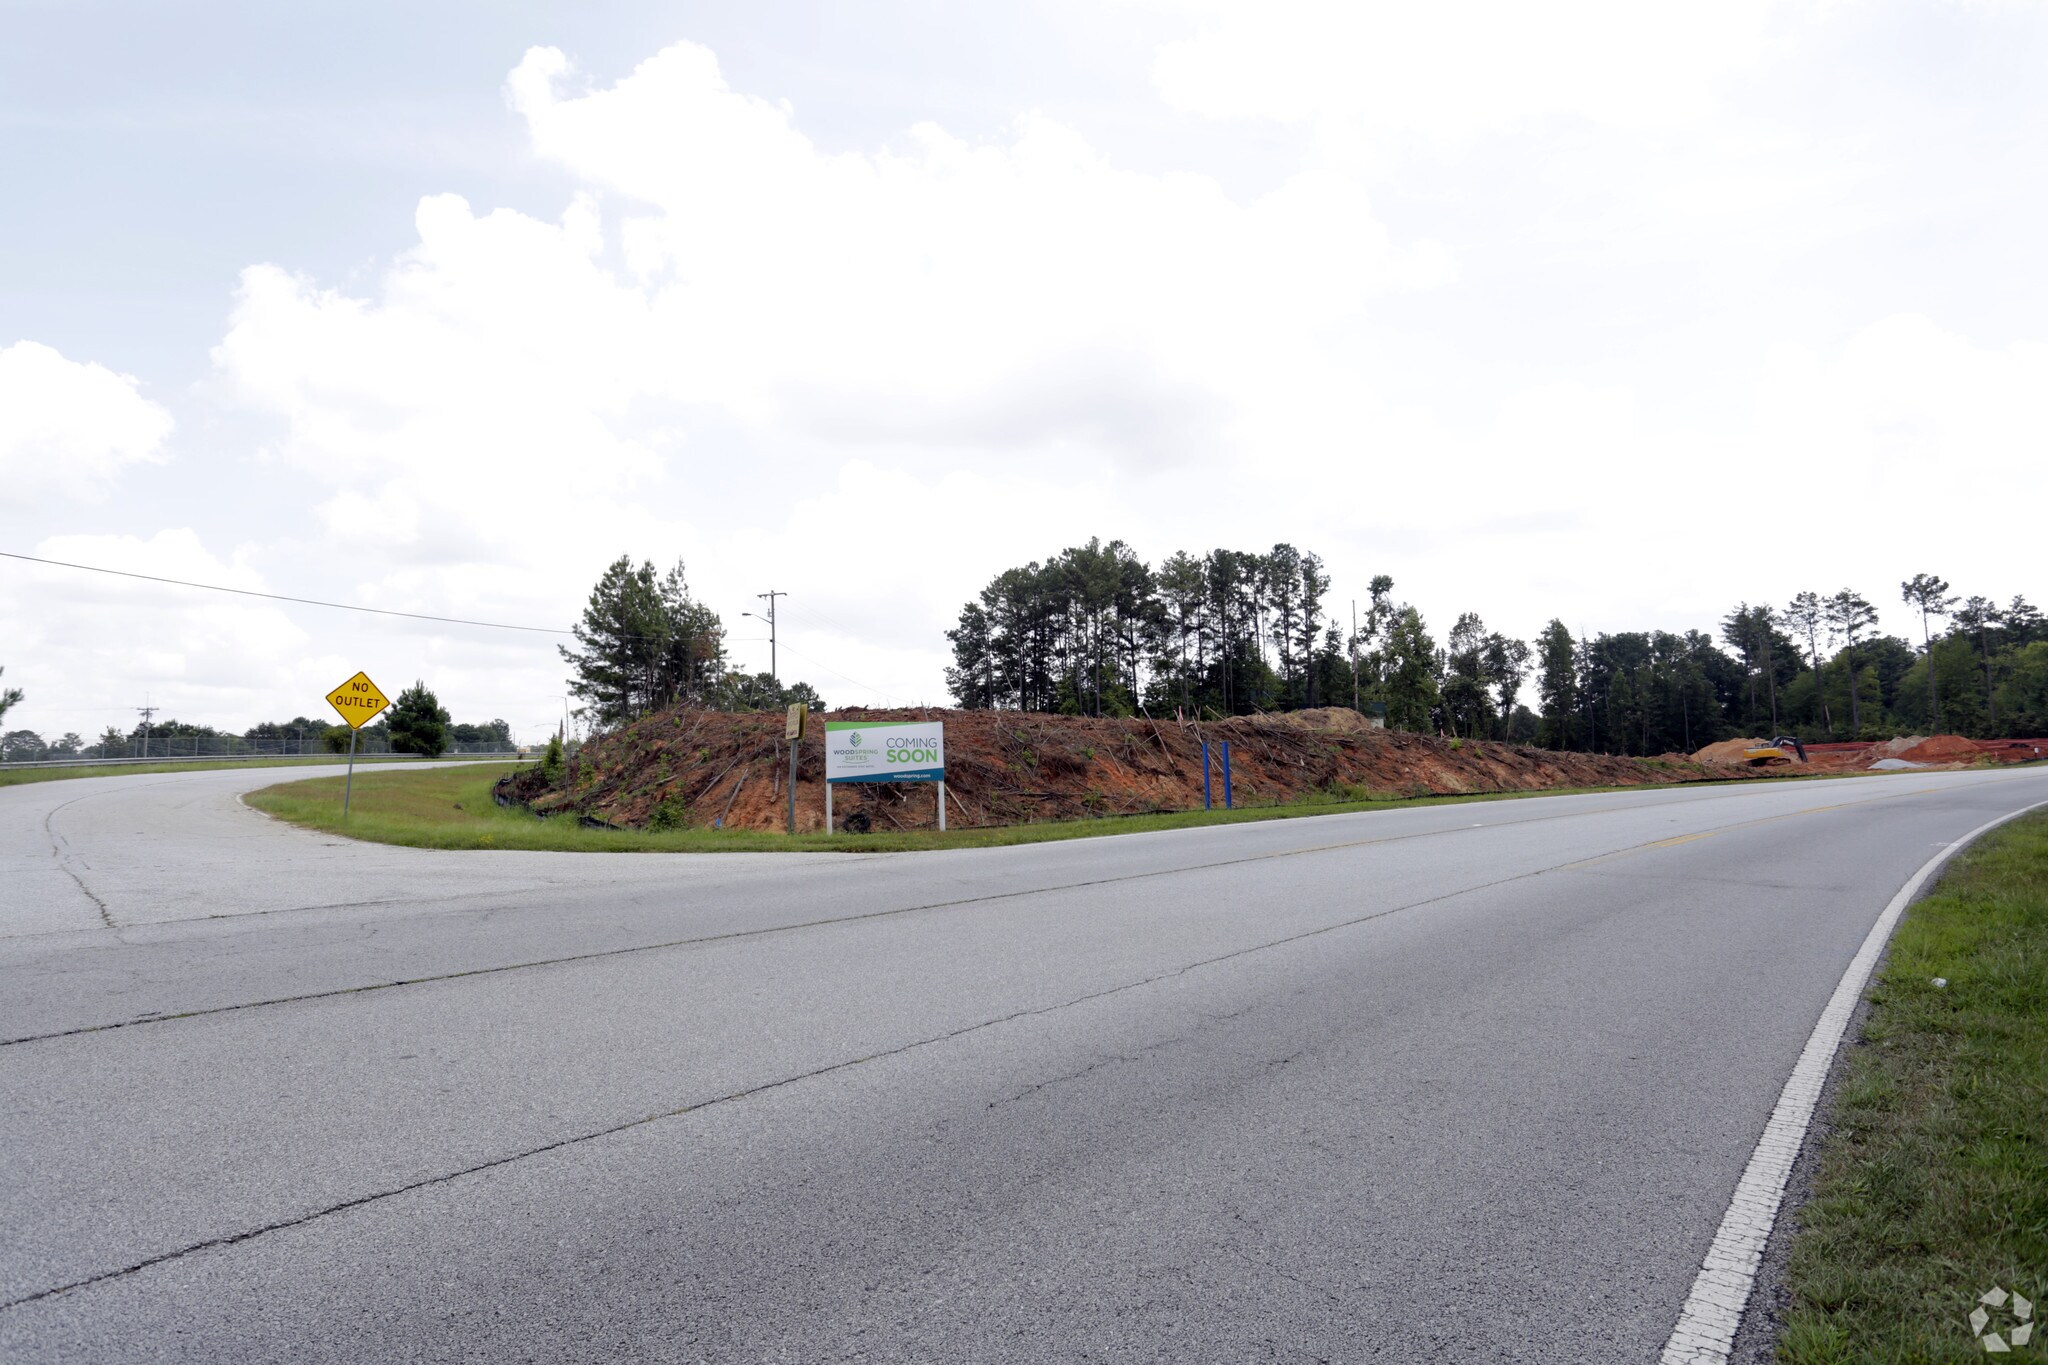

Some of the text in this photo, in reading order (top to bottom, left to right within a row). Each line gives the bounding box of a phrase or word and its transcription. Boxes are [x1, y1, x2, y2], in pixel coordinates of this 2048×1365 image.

[352, 682, 369, 693] NO
[335, 695, 380, 708] OUTLET
[886, 737, 938, 749] COMING
[886, 749, 938, 763] SOON
